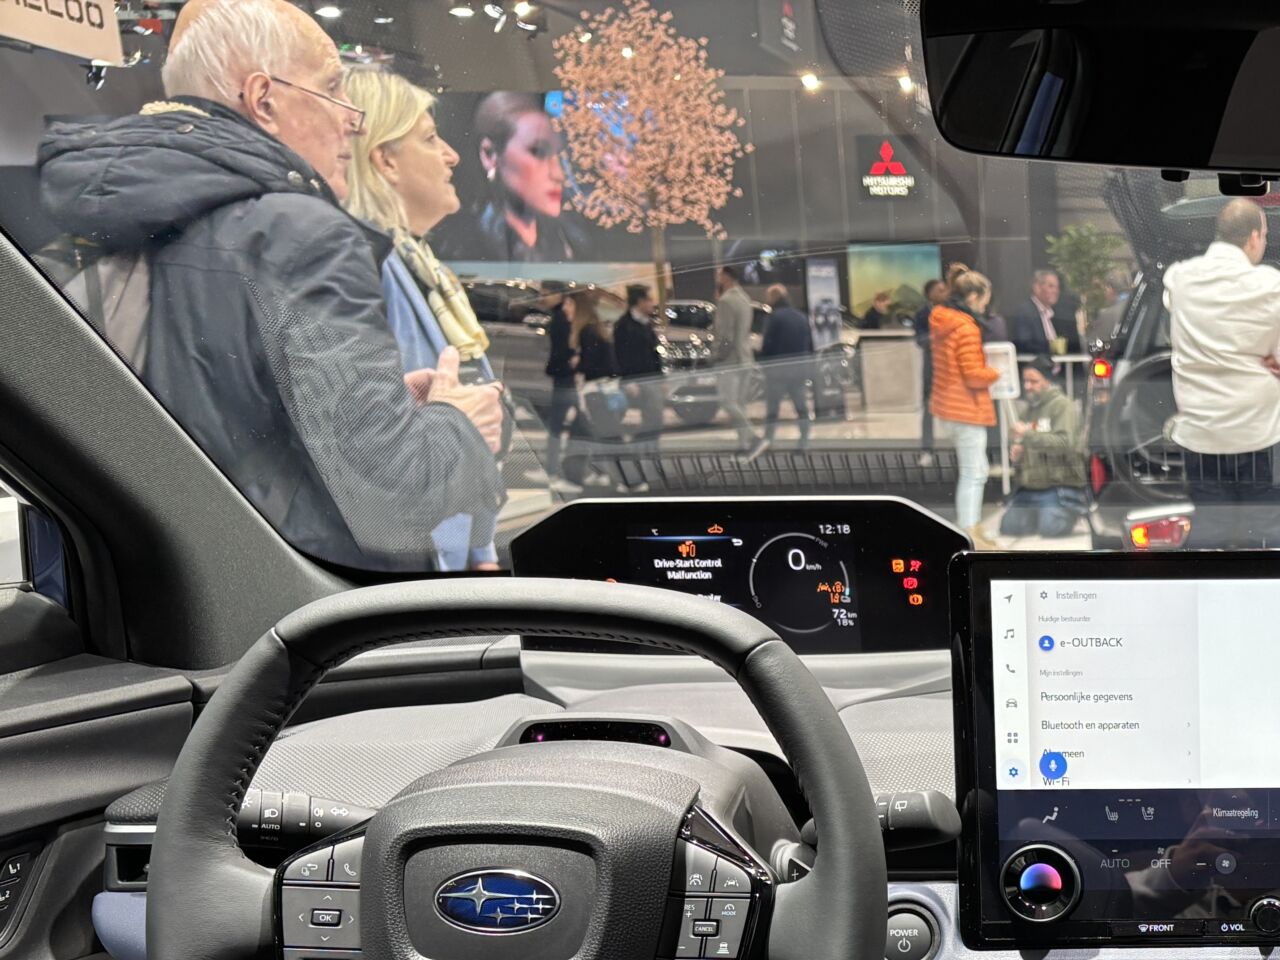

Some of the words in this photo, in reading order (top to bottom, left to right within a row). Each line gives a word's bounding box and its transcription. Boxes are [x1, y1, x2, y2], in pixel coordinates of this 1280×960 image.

[862, 175, 915, 187] MITSUBISHI
[869, 186, 909, 196] MOTORS
[818, 524, 851, 535] 12:18
[653, 558, 694, 568] Drive-Start
[694, 558, 722, 568] Control
[787, 548, 806, 571] 0
[805, 563, 822, 571] km/h
[666, 570, 713, 580] Malfunction
[1056, 591, 1097, 601] Instellingen
[832, 608, 847, 618] 72
[837, 618, 855, 626] 18%
[1060, 637, 1123, 648] e-OUTBACK
[1040, 691, 1091, 703] Persoonlijke
[1093, 694, 1133, 703] gegevens
[1041, 720, 1084, 730] Bluetooth
[1085, 722, 1096, 730] en
[1097, 721, 1140, 731] apparaten
[1212, 807, 1259, 819] Klimaatregeling
[1100, 858, 1130, 868] AUTO
[1150, 859, 1172, 869] OFF
[318, 913, 332, 922] OK
[1149, 924, 1175, 933] FRONT
[1229, 923, 1245, 932] VOL
[889, 929, 919, 937] POWER
